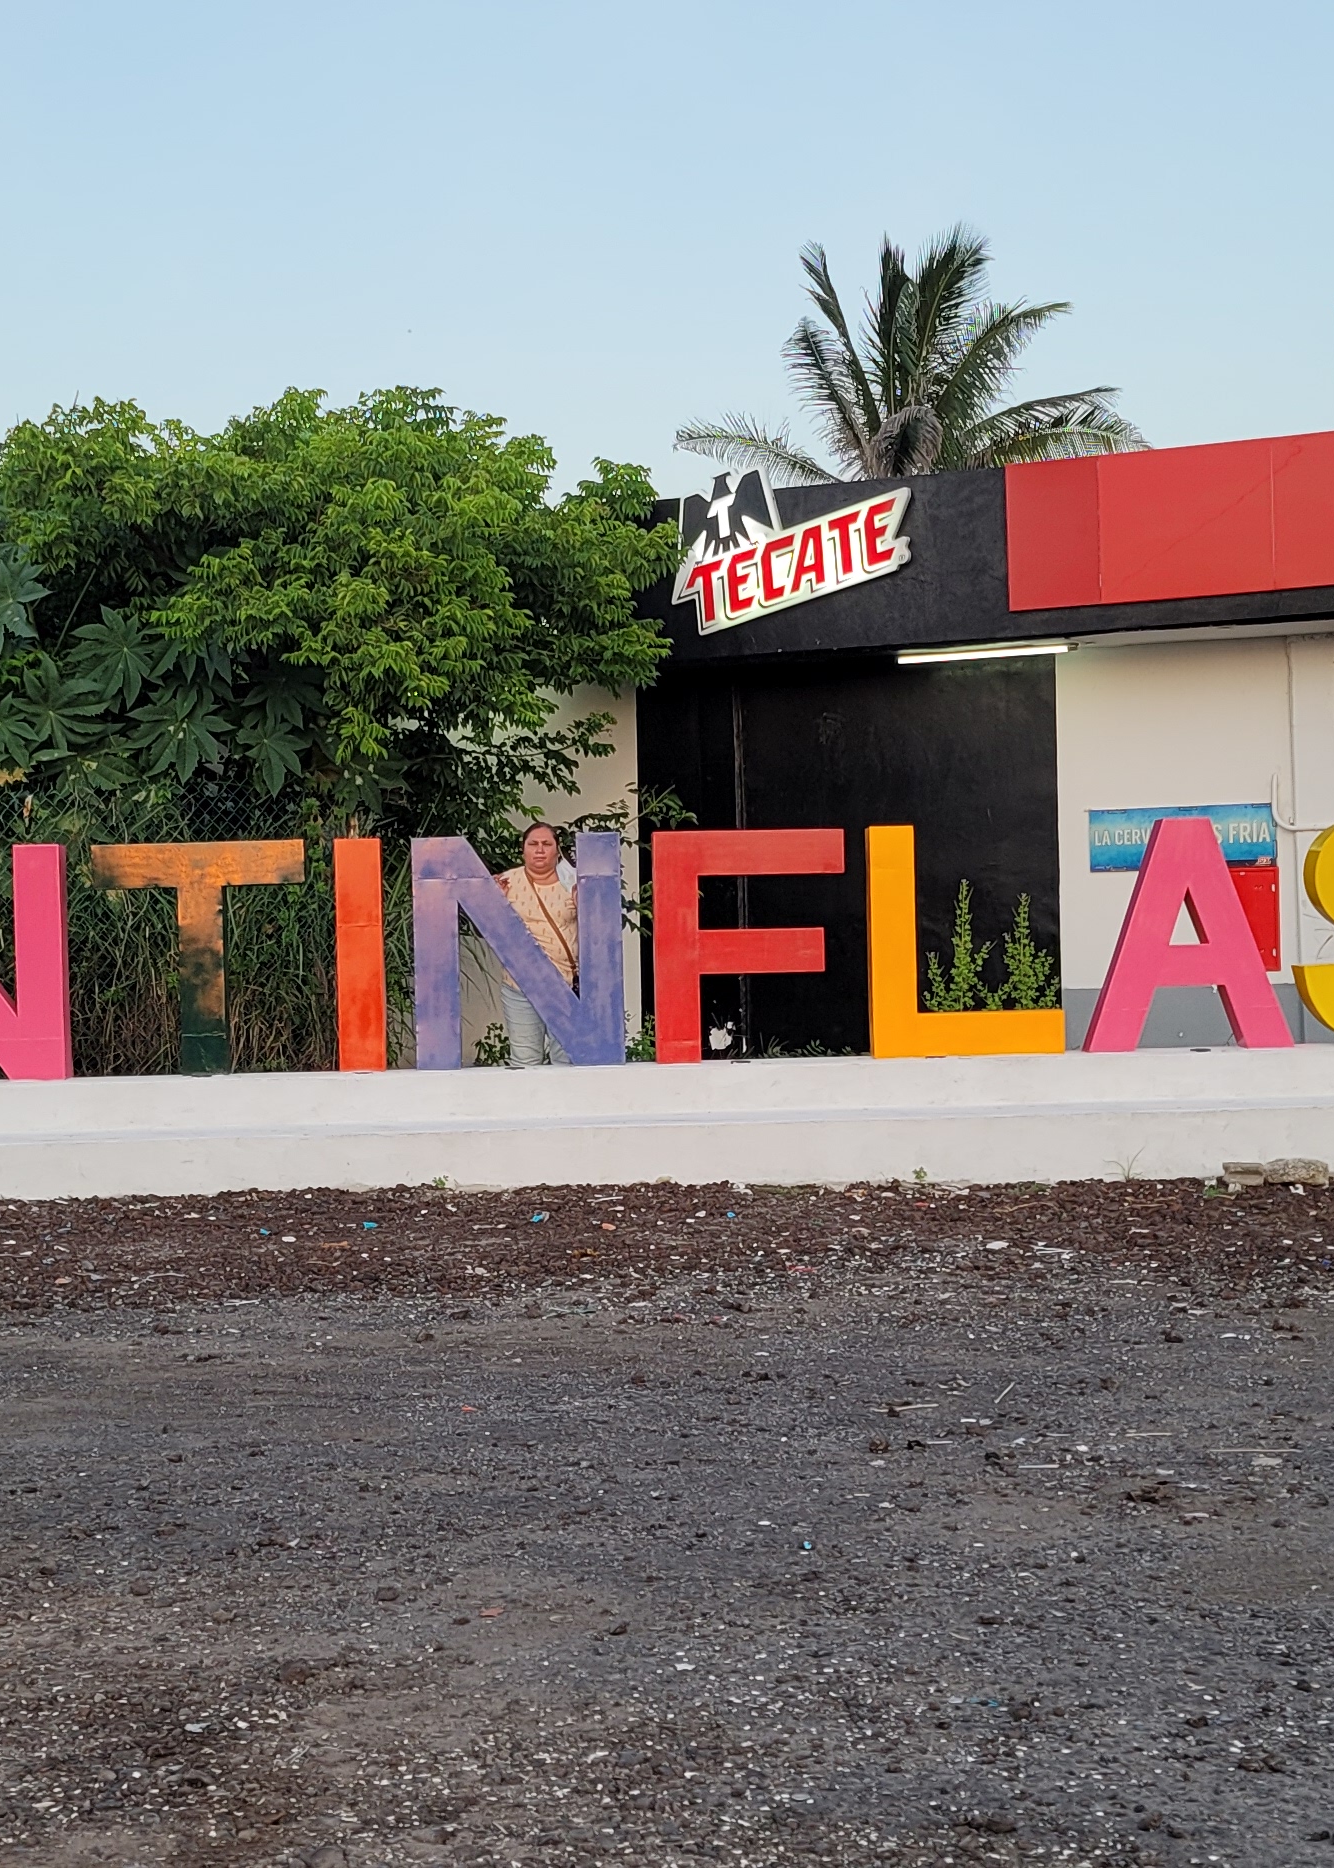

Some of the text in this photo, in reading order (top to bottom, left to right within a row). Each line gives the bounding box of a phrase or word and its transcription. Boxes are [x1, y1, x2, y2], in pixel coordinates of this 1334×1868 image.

[685, 497, 897, 623] TECATE
[1094, 830, 1111, 846] LA
[1114, 828, 1151, 846] CERV
[1229, 821, 1271, 845] FRÍA
